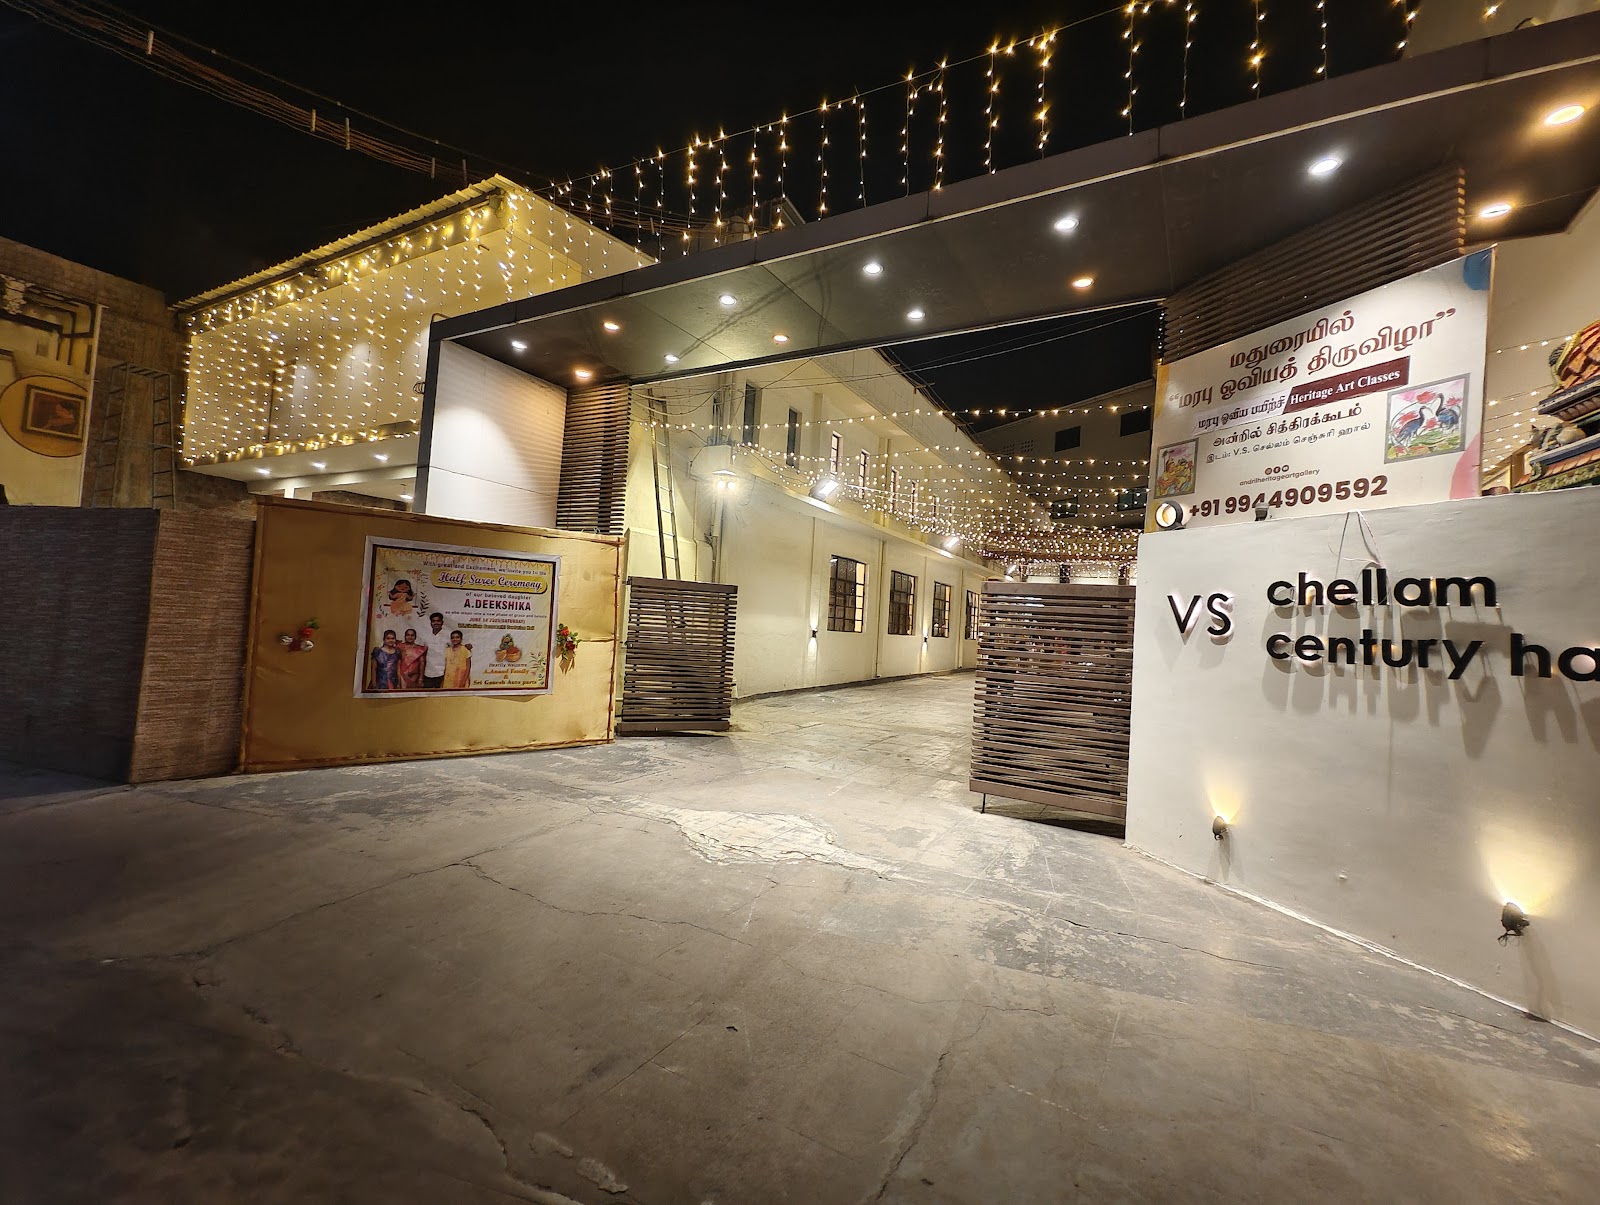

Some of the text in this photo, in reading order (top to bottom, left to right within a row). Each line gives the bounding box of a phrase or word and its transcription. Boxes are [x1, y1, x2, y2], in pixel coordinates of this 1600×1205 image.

[1229, 310, 1355, 369] மதுரையில்
[1220, 357, 1298, 400] ஓவியத்
[1290, 370, 1401, 405] Heritage Art Classes
[1212, 402, 1363, 447] அன்றில் சித்திரக்கூடம்
[1233, 446, 1251, 456] V.S.
[1338, 422, 1371, 437] ஹால்
[1189, 475, 1388, 518] +91 9944909592
[438, 571, 543, 590] Half Saree Ceremony
[1266, 568, 1497, 608] chellam
[463, 598, 531, 611] A.DEEKSHIKA
[1166, 592, 1233, 638] VS
[1266, 628, 1486, 680] century
